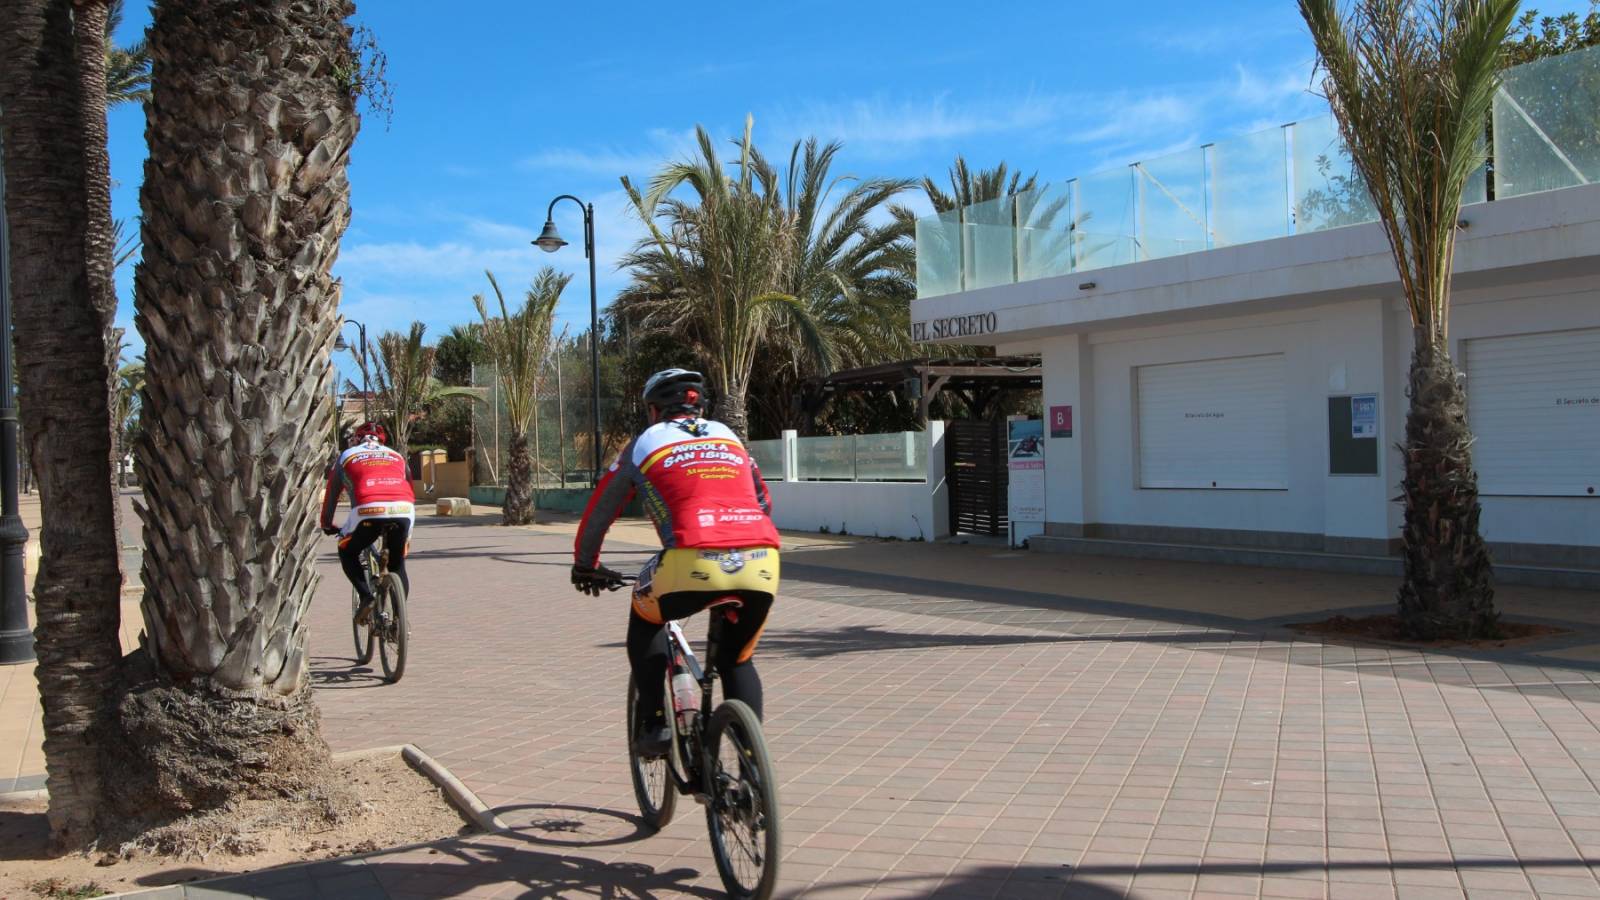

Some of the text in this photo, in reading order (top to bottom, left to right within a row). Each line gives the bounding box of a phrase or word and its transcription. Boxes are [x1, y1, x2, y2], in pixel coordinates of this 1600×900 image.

[912, 311, 997, 341] EL SECRETO
[1057, 411, 1065, 425] B
[671, 443, 729, 454] AVICOLA
[663, 451, 744, 468] SAN ISIDRO
